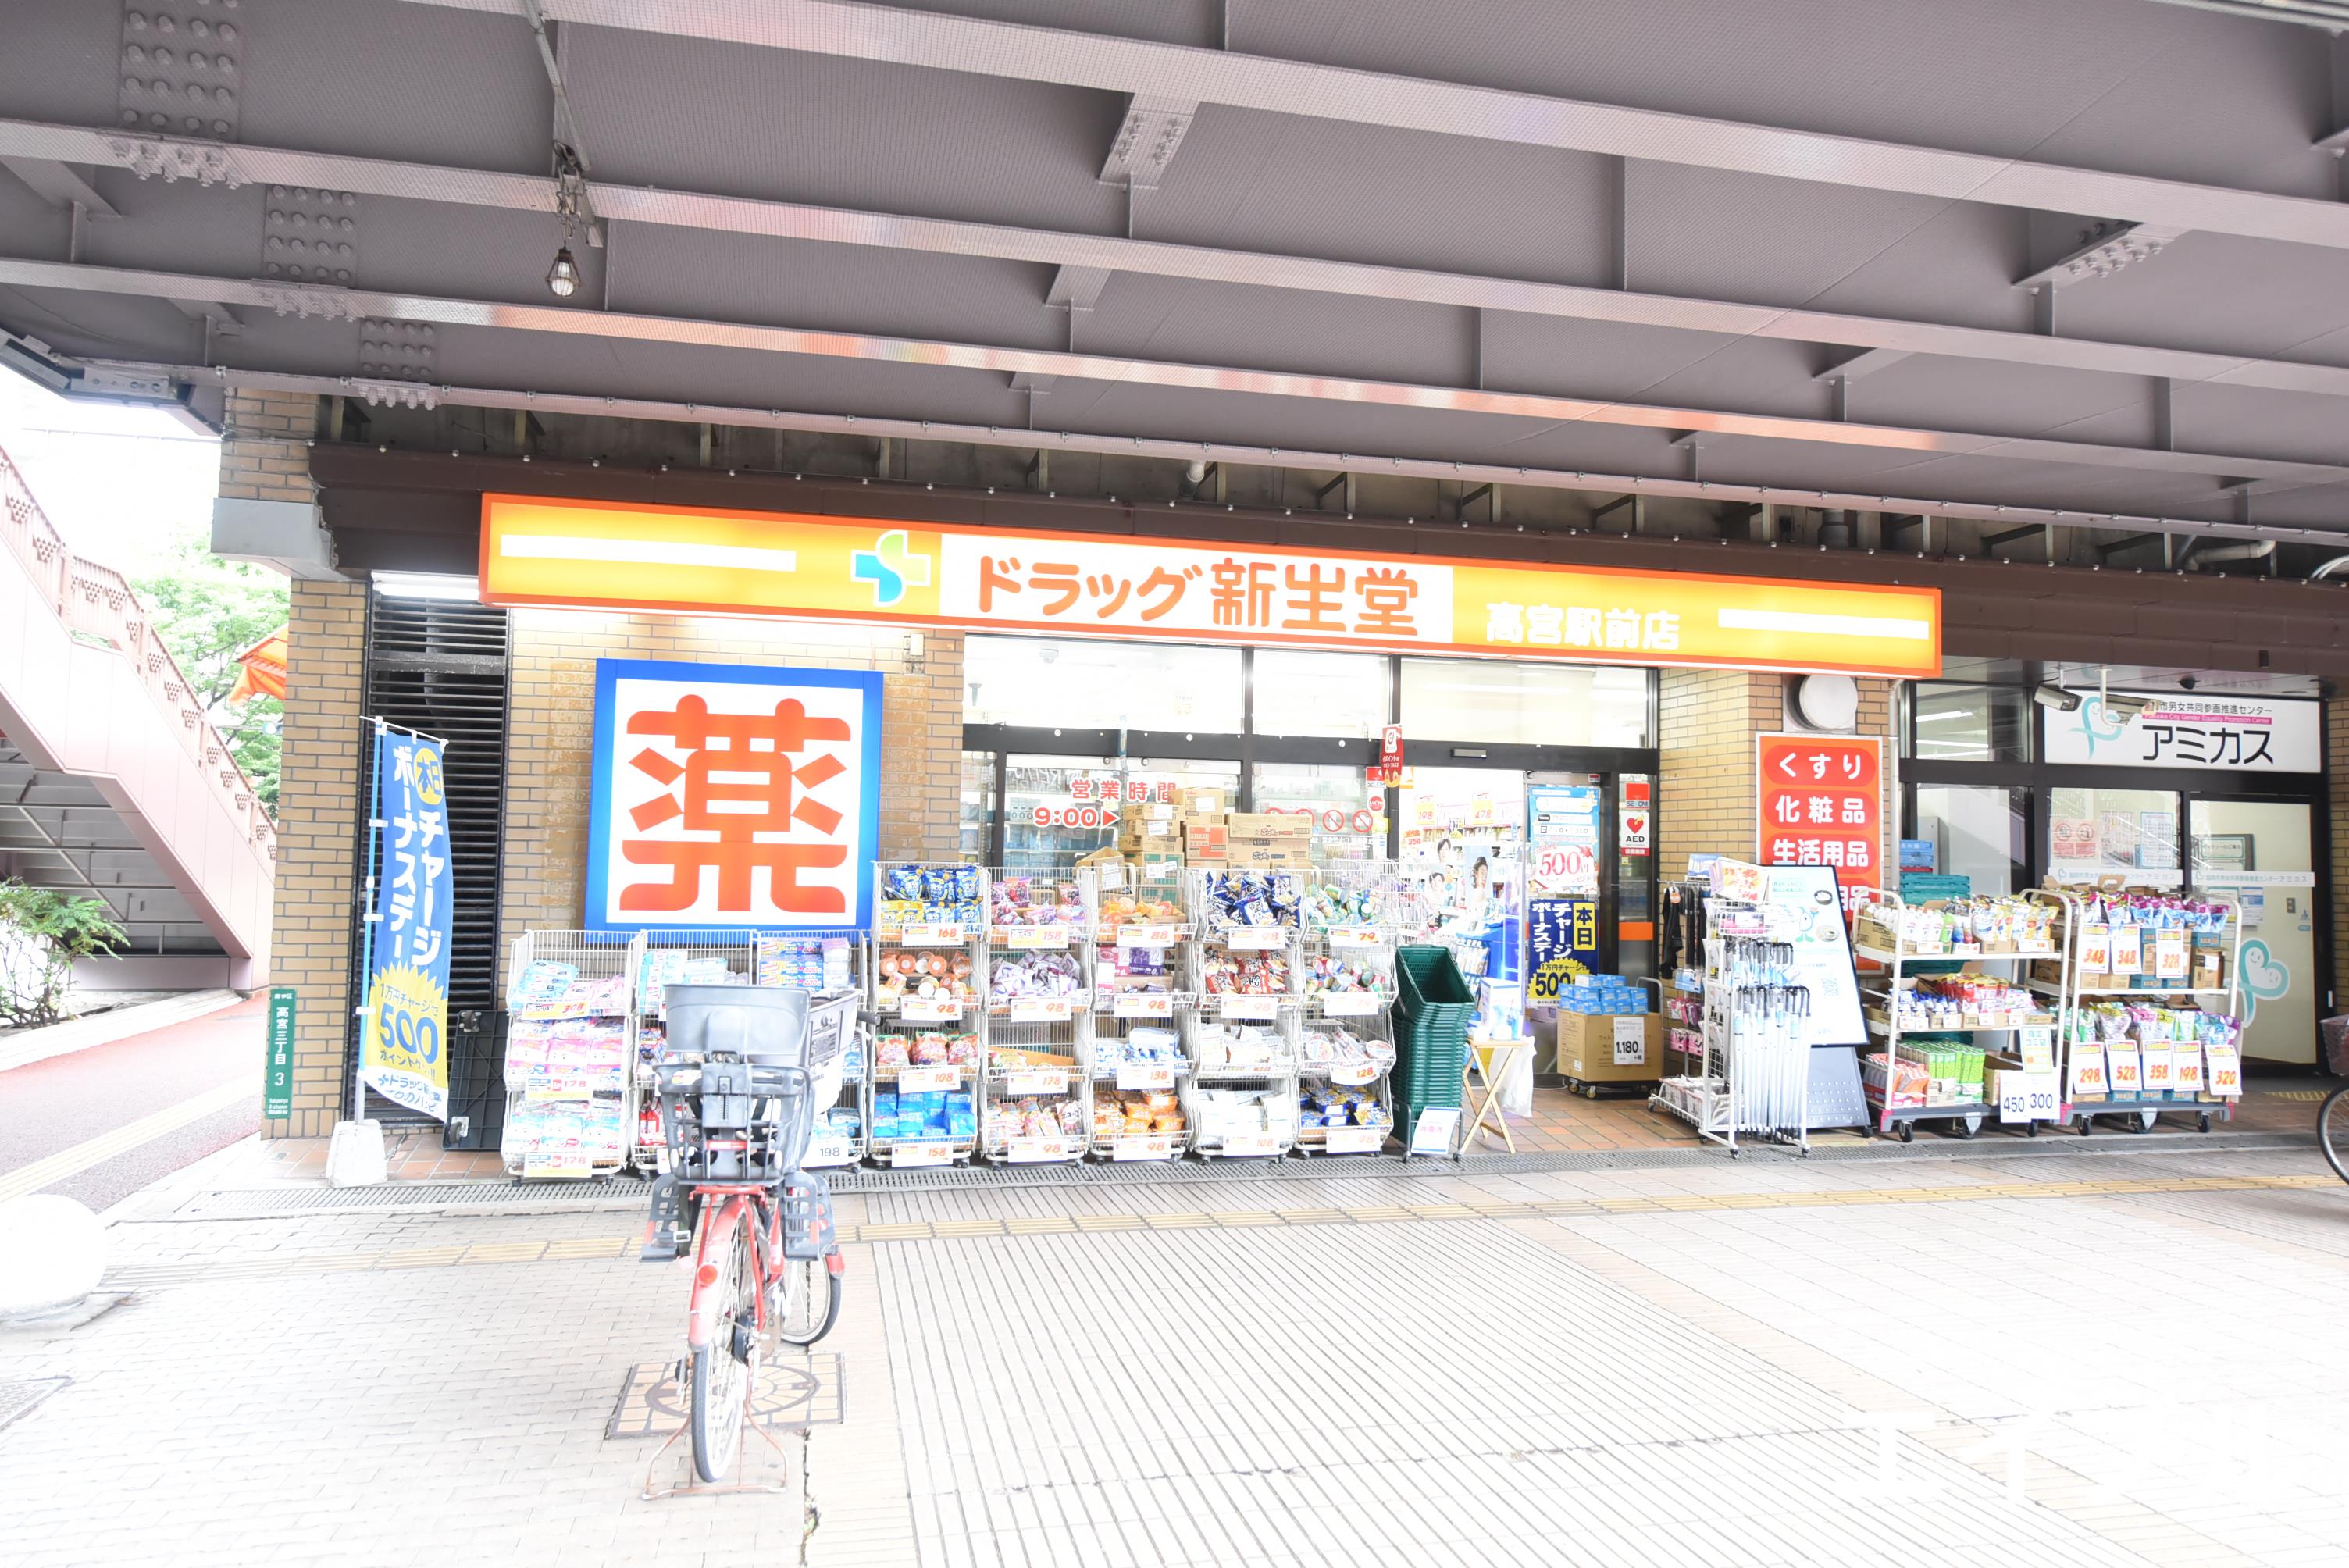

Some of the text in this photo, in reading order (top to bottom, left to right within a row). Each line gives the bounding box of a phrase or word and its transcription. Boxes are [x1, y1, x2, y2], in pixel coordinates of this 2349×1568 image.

[978, 555, 1418, 636] ドラッグ新生堂
[1485, 601, 1680, 650] 高宮駅前店
[2159, 700, 2272, 715] 市男女共同参画推進センター
[2142, 725, 2274, 765] アミカス
[1780, 753, 1861, 779] くすり
[416, 757, 441, 793] 本日
[1071, 779, 1177, 802] 営業時間
[619, 693, 851, 913] 薬
[1776, 795, 1865, 824] 化粧品
[1034, 807, 1099, 826] 9:00
[1418, 811, 1433, 820] 198
[390, 745, 418, 959] ボーナスデー
[1773, 839, 1869, 868] 生活用品
[1539, 851, 1581, 876] 500
[412, 811, 444, 967] チャージ
[937, 928, 957, 938] 168
[1532, 902, 1552, 962] ボーナスデー
[1552, 903, 1572, 958] チャージ
[1575, 907, 1593, 946] 本日
[1043, 930, 1061, 940] 158
[1150, 930, 1169, 940] 88
[1358, 932, 1376, 941] 79
[2083, 948, 2106, 964] 348
[2117, 948, 2137, 964] 348
[2162, 953, 2181, 968] 328
[803, 965, 819, 974] 400
[803, 978, 818, 986] 400
[380, 982, 439, 1017] 1万円チャージで
[1148, 1000, 1167, 1010] 98
[1254, 1002, 1271, 1011] 98
[562, 1002, 584, 1014] 308
[937, 1003, 956, 1013] 98
[1046, 1003, 1064, 1012] 98
[275, 1007, 289, 1065] 高宮三丁目
[380, 1002, 439, 1064] 500
[274, 1072, 285, 1086] 3
[934, 1072, 954, 1082] 108
[1150, 1071, 1167, 1080] 138
[1356, 1066, 1374, 1078] 128
[2079, 1067, 2101, 1083] 298
[2116, 1065, 2137, 1081] 528
[2149, 1064, 2169, 1079] 358
[2179, 1066, 2198, 1082] 198
[2215, 1070, 2237, 1085] 320
[1042, 1076, 1061, 1086] 178
[2003, 1096, 2025, 1113] 450
[2030, 1092, 2053, 1109] 300
[1043, 1144, 1062, 1153] 98
[1146, 1142, 1165, 1152] 98
[1256, 1138, 1274, 1147] 108
[819, 1146, 841, 1158] 198
[928, 1147, 947, 1156] 158
